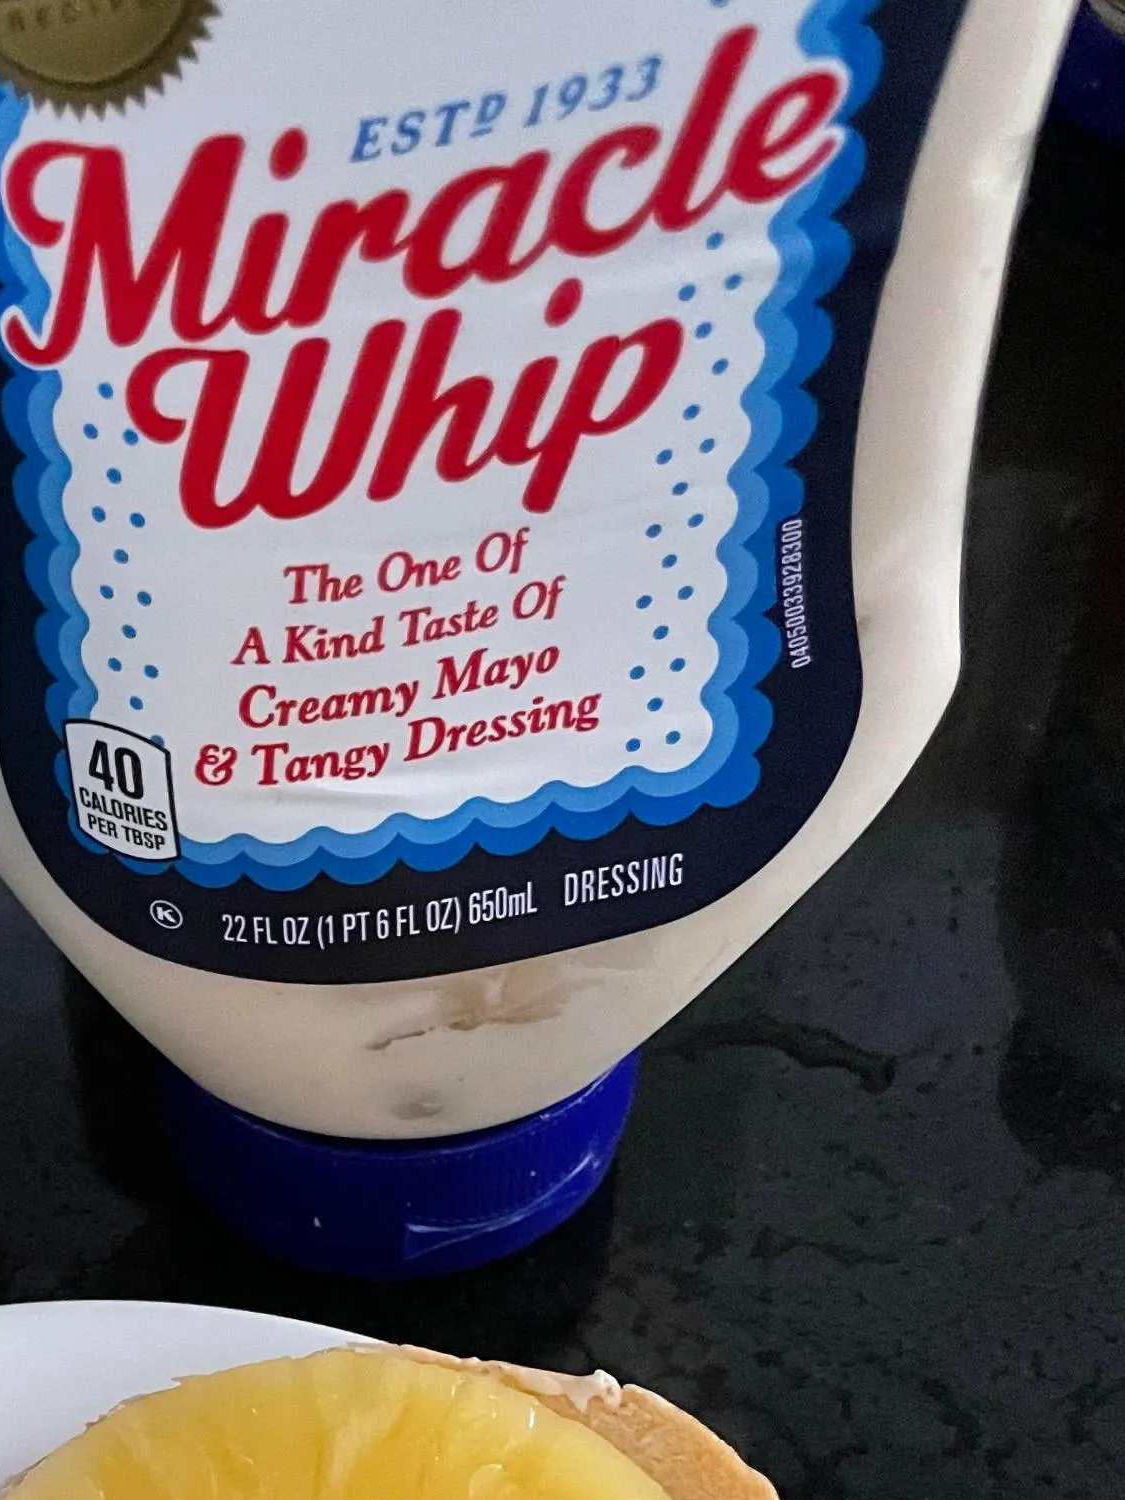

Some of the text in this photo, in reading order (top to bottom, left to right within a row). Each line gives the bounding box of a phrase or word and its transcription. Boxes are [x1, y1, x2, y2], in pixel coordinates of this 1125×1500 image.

[524, 53, 663, 128] 1933
[3, 25, 841, 364] Miracle
[125, 278, 684, 528] Whip
[283, 526, 530, 605] The One Of
[231, 575, 567, 665] A Kind Taste Of
[239, 646, 560, 728] Creamy Mayo
[89, 739, 144, 800] 40
[195, 692, 603, 787] & Tangy Dressing
[79, 787, 168, 831] CALORIES
[87, 813, 165, 851] PER TBSP
[222, 881, 538, 950] 22 FL OZ (1 PT 6 FL OZ) 650mL
[564, 853, 684, 907] DRESSING
